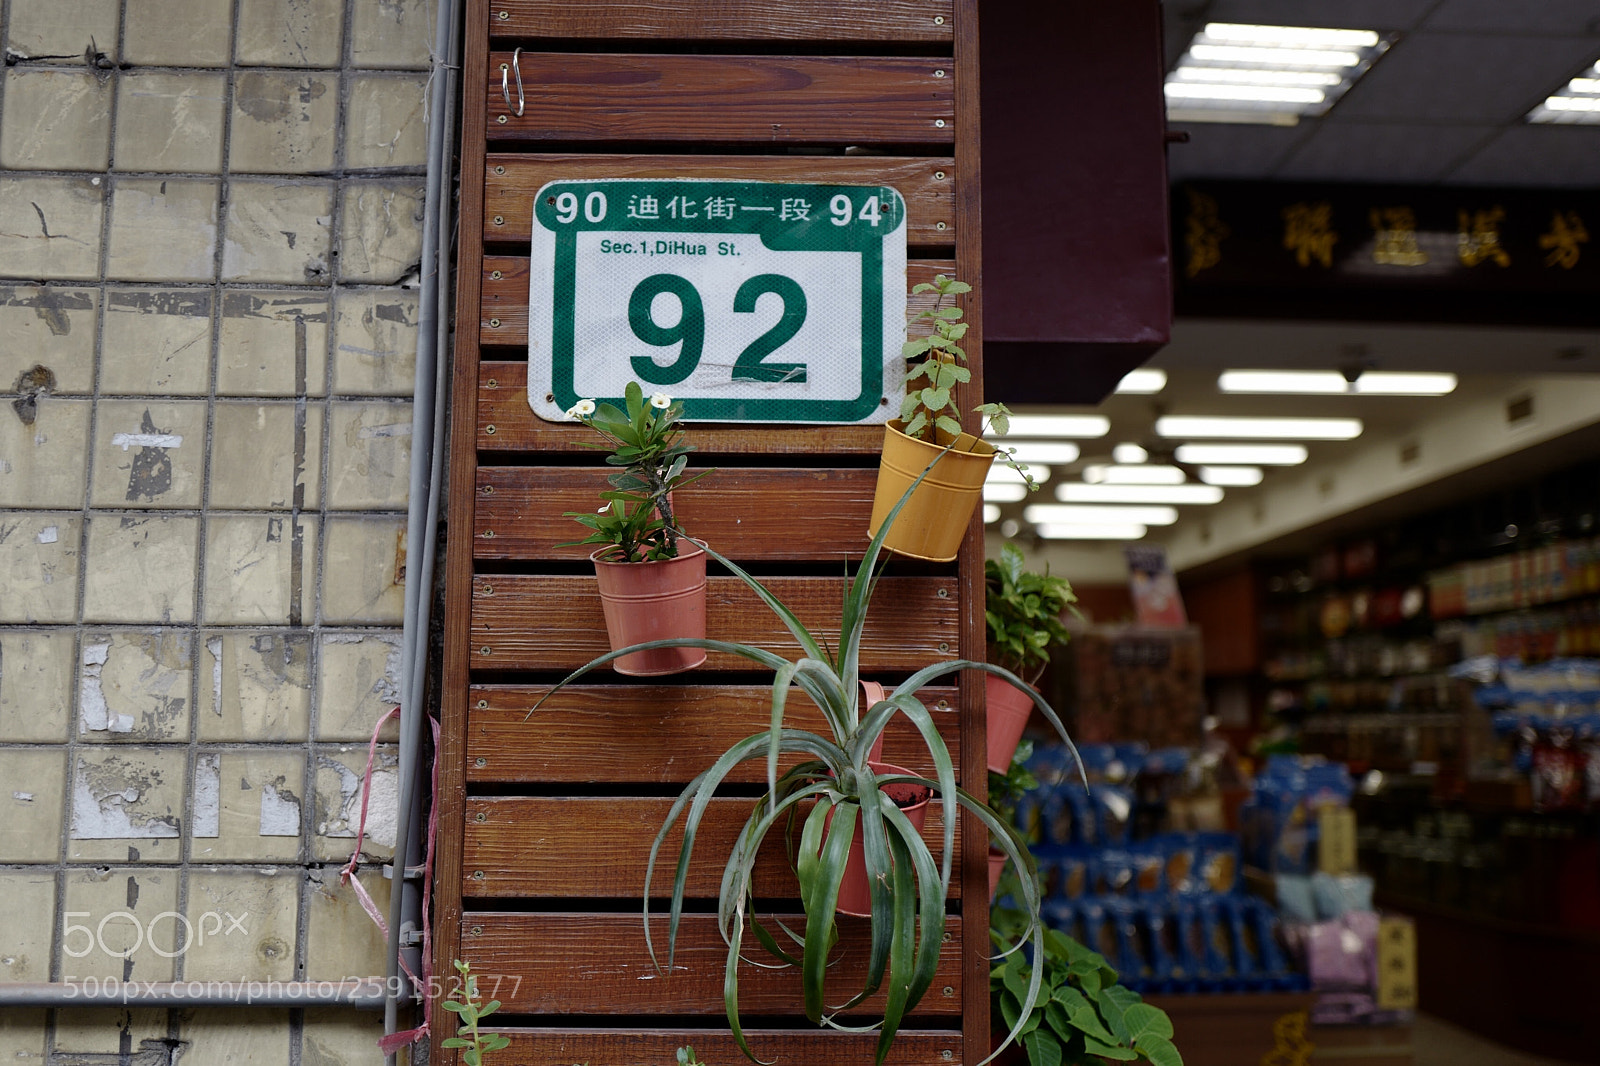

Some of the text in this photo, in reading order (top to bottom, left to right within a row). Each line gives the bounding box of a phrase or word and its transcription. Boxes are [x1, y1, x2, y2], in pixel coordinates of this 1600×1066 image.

[555, 191, 608, 224] 90
[626, 194, 813, 222] 迪化街一段
[829, 194, 882, 227] 94
[600, 239, 741, 257] Sec.1,DiHua St.
[627, 272, 808, 386] 92
